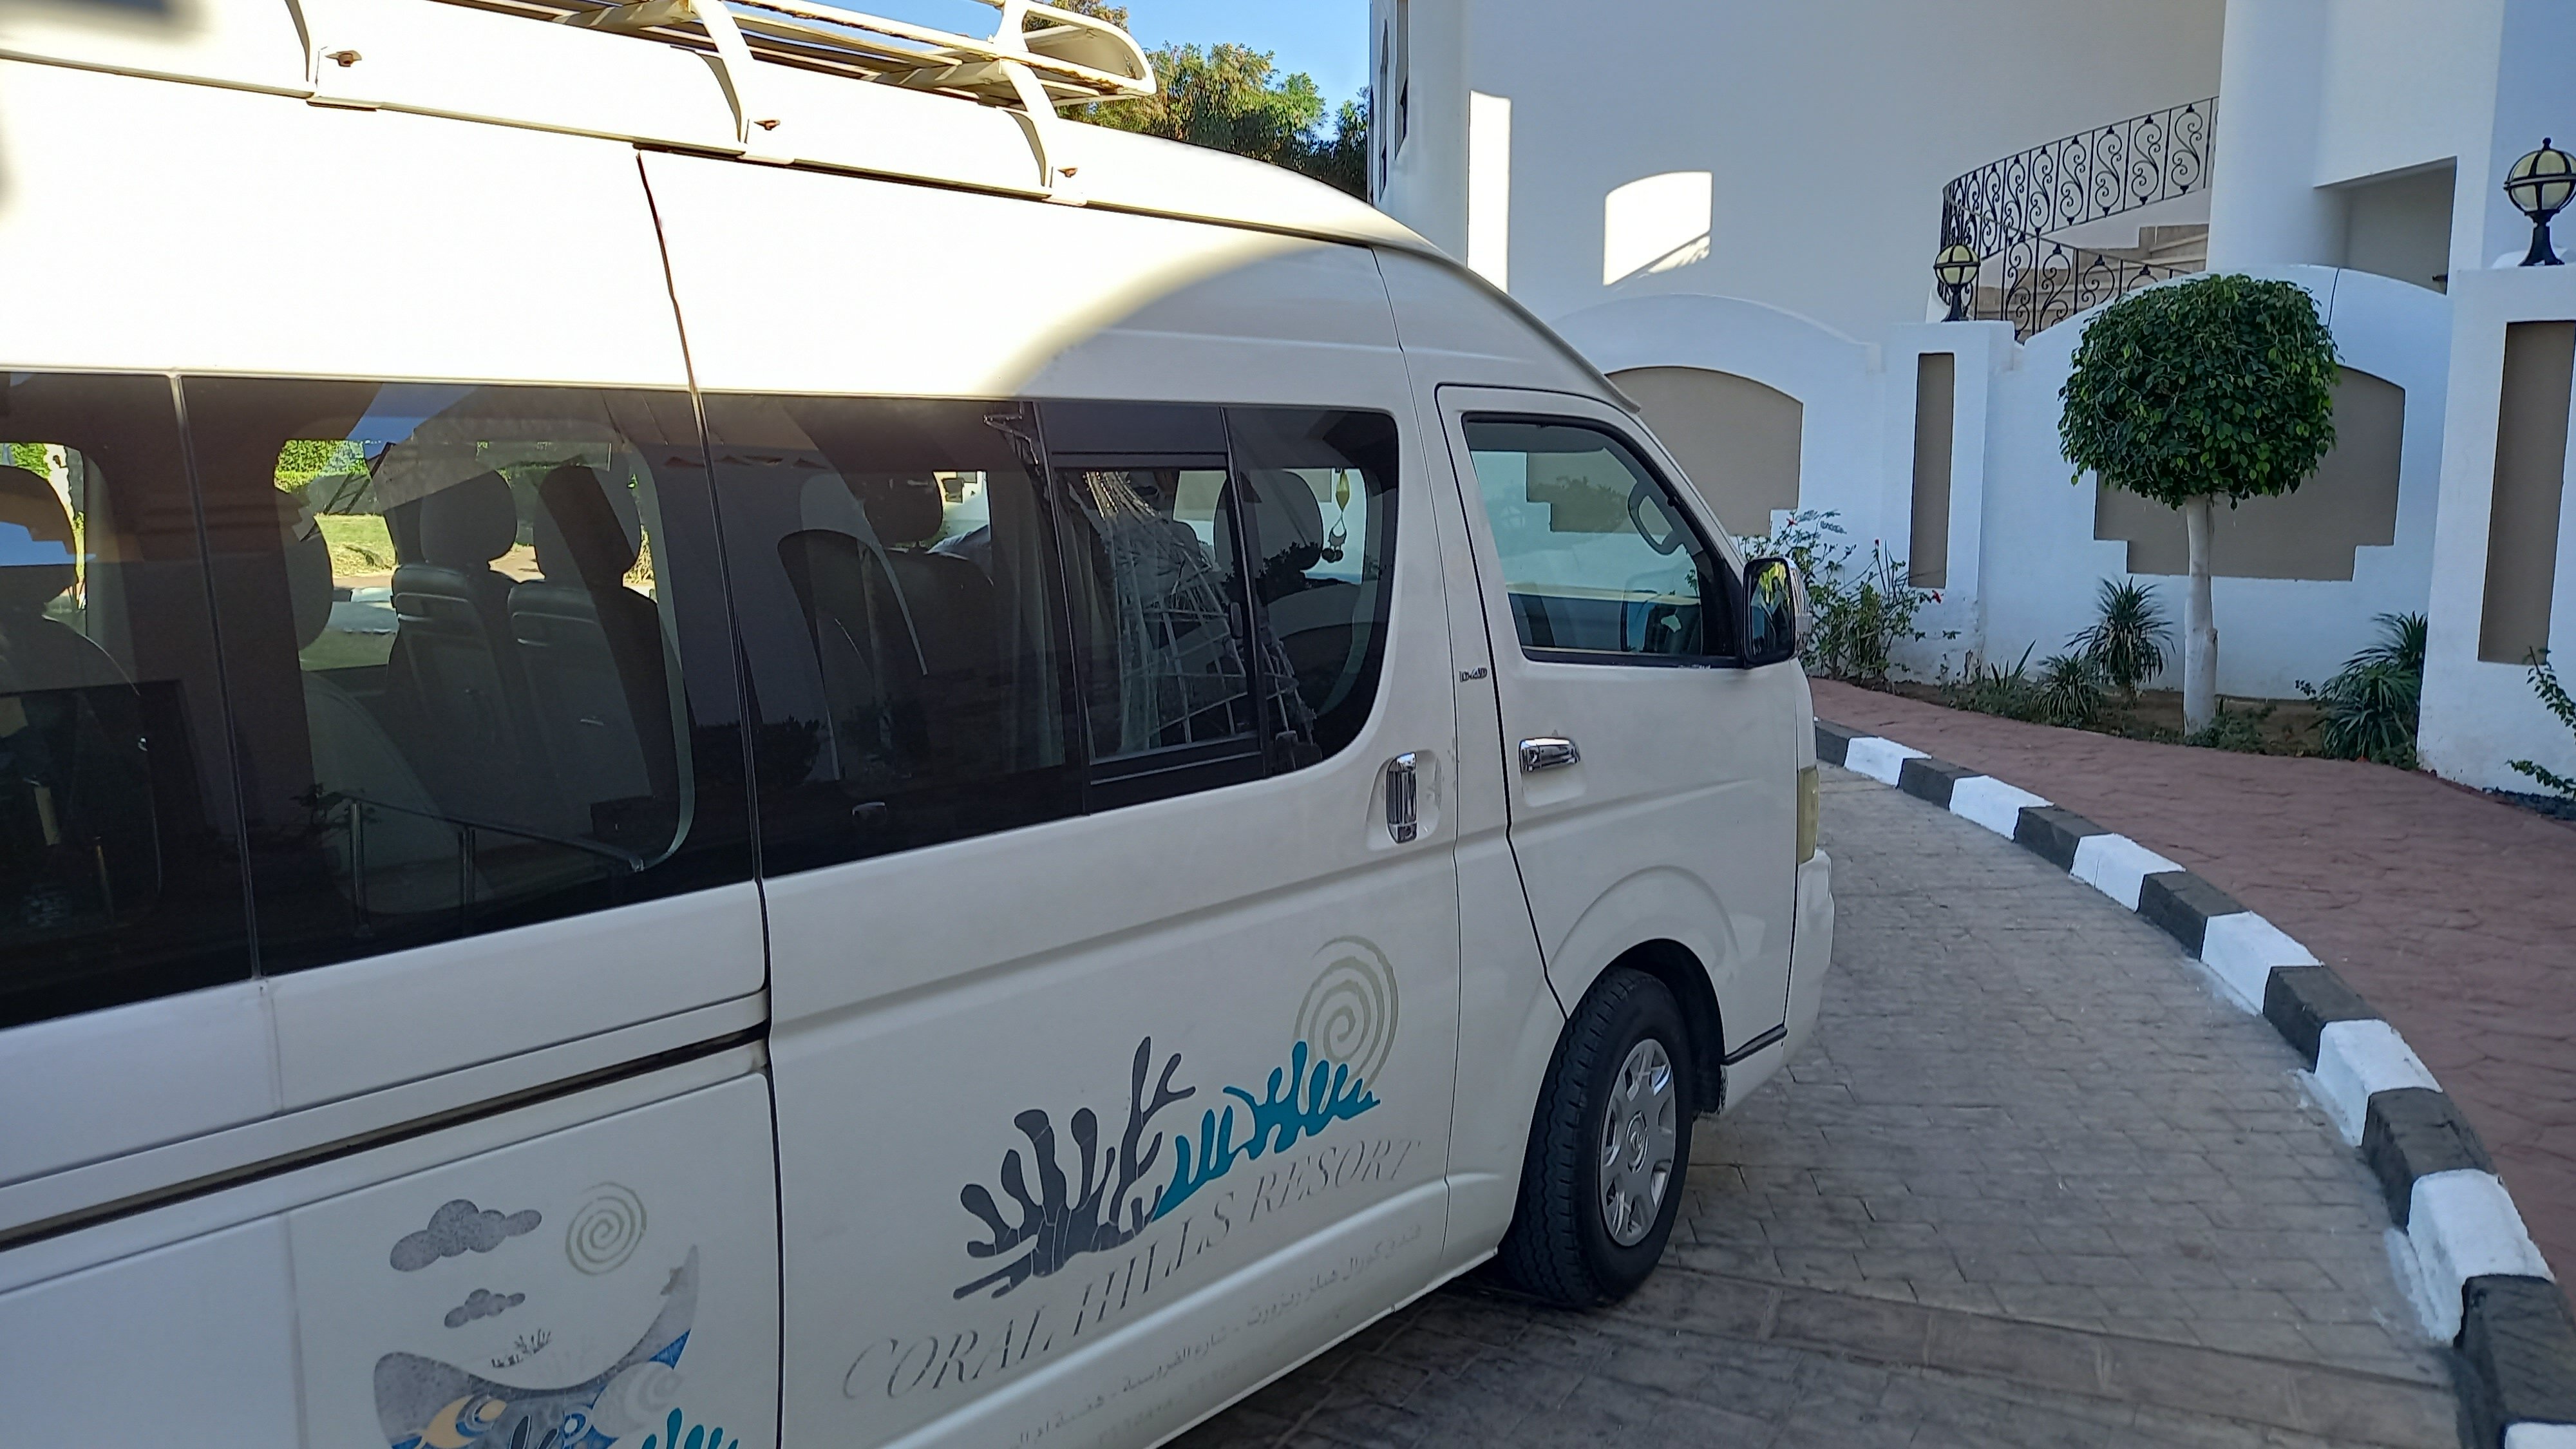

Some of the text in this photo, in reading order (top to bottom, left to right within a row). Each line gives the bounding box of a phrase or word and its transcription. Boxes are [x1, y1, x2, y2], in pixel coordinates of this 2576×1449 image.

[1459, 667, 1488, 683] D-4D
[842, 1139, 1421, 1399] CORAL HILLS RESORT
